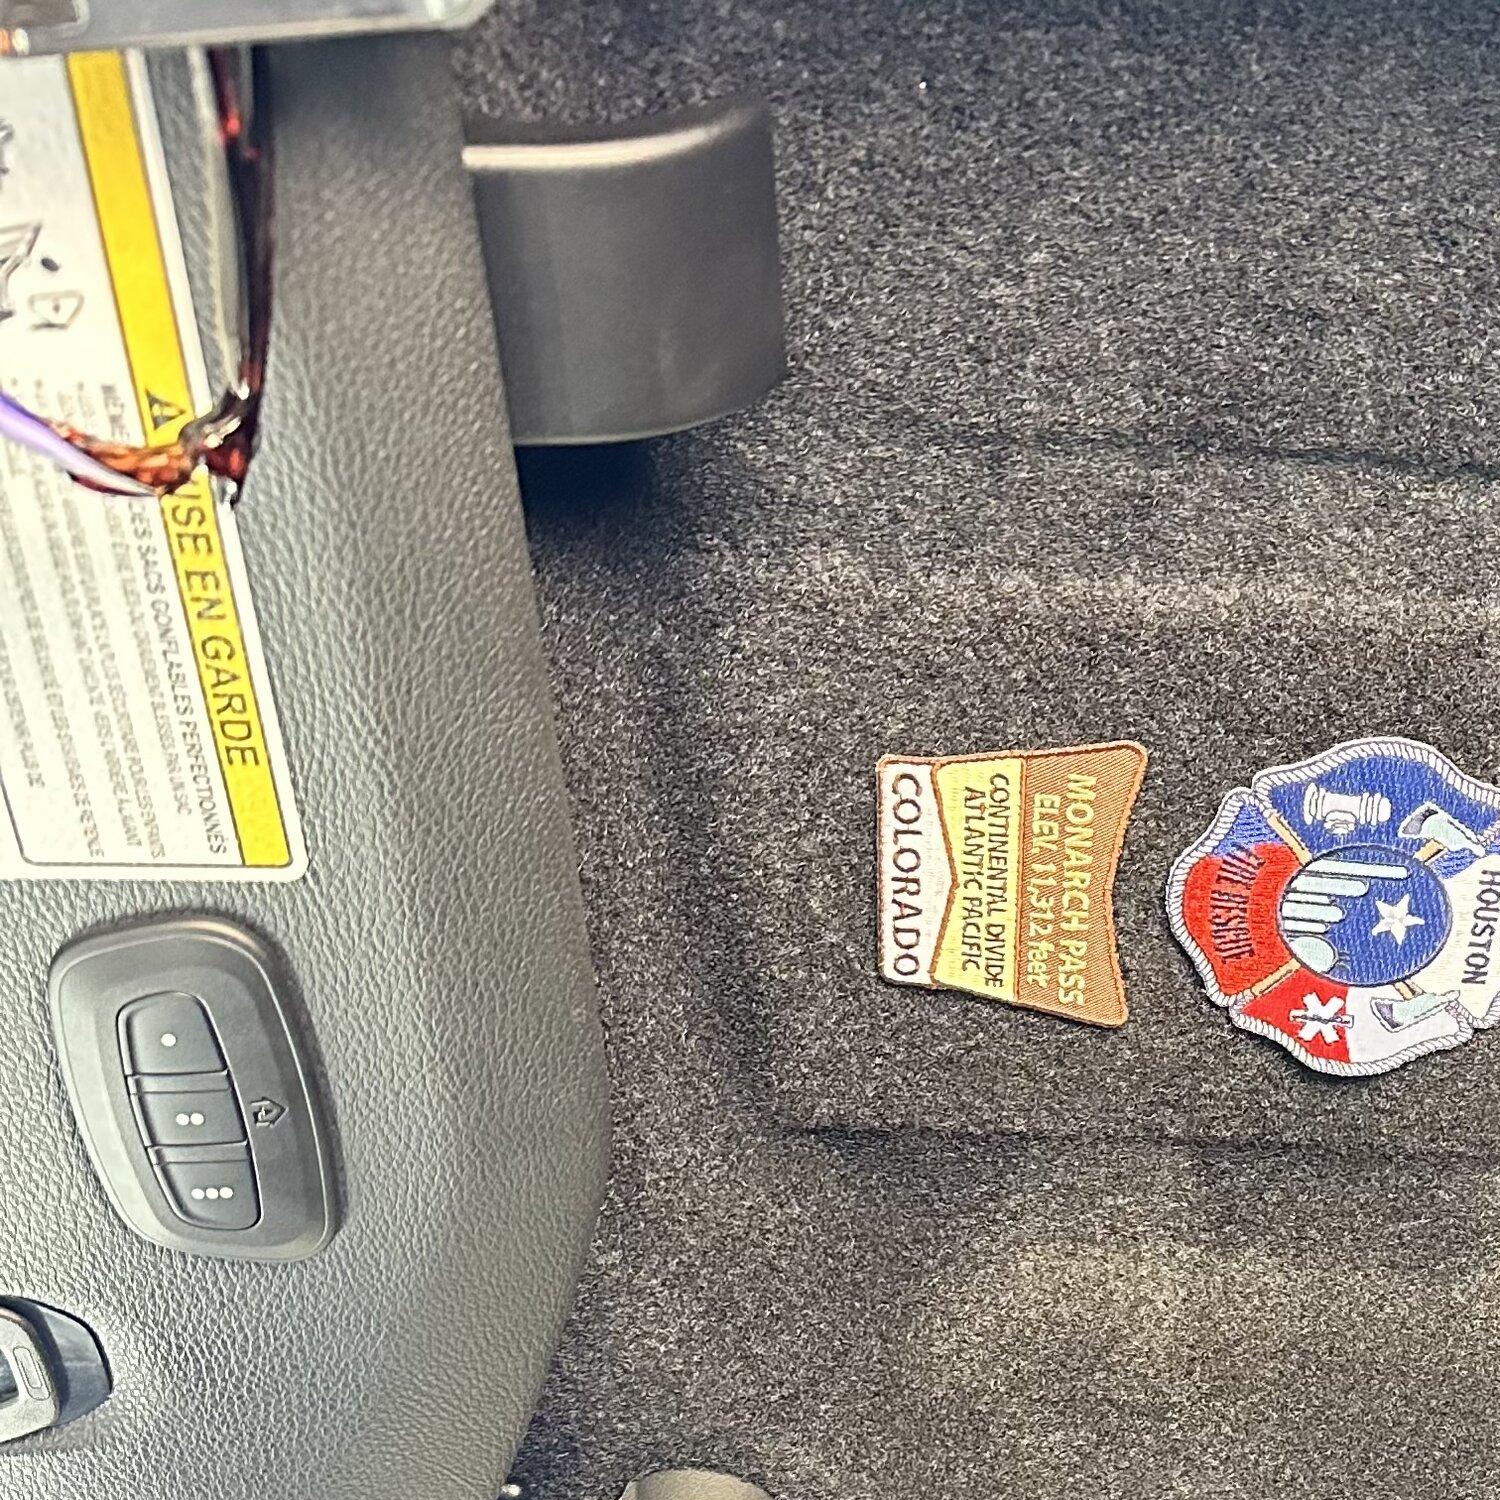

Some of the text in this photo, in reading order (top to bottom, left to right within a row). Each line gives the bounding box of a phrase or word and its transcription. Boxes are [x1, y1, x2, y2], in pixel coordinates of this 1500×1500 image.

[139, 545, 167, 595] SACS
[179, 721, 229, 855] PERFECTIONNÉS
[168, 480, 260, 767] ISE EN GARDE
[891, 773, 923, 977] COLORADO
[962, 786, 986, 972] ATLANTIC PACIFIC
[984, 773, 1010, 988] CONTINENTAL DIVIDE
[1027, 793, 1060, 987] ELEV. 11,312 feet
[1057, 772, 1097, 1006] MONARCH PASS
[1209, 844, 1266, 963] FIRE RESCUE
